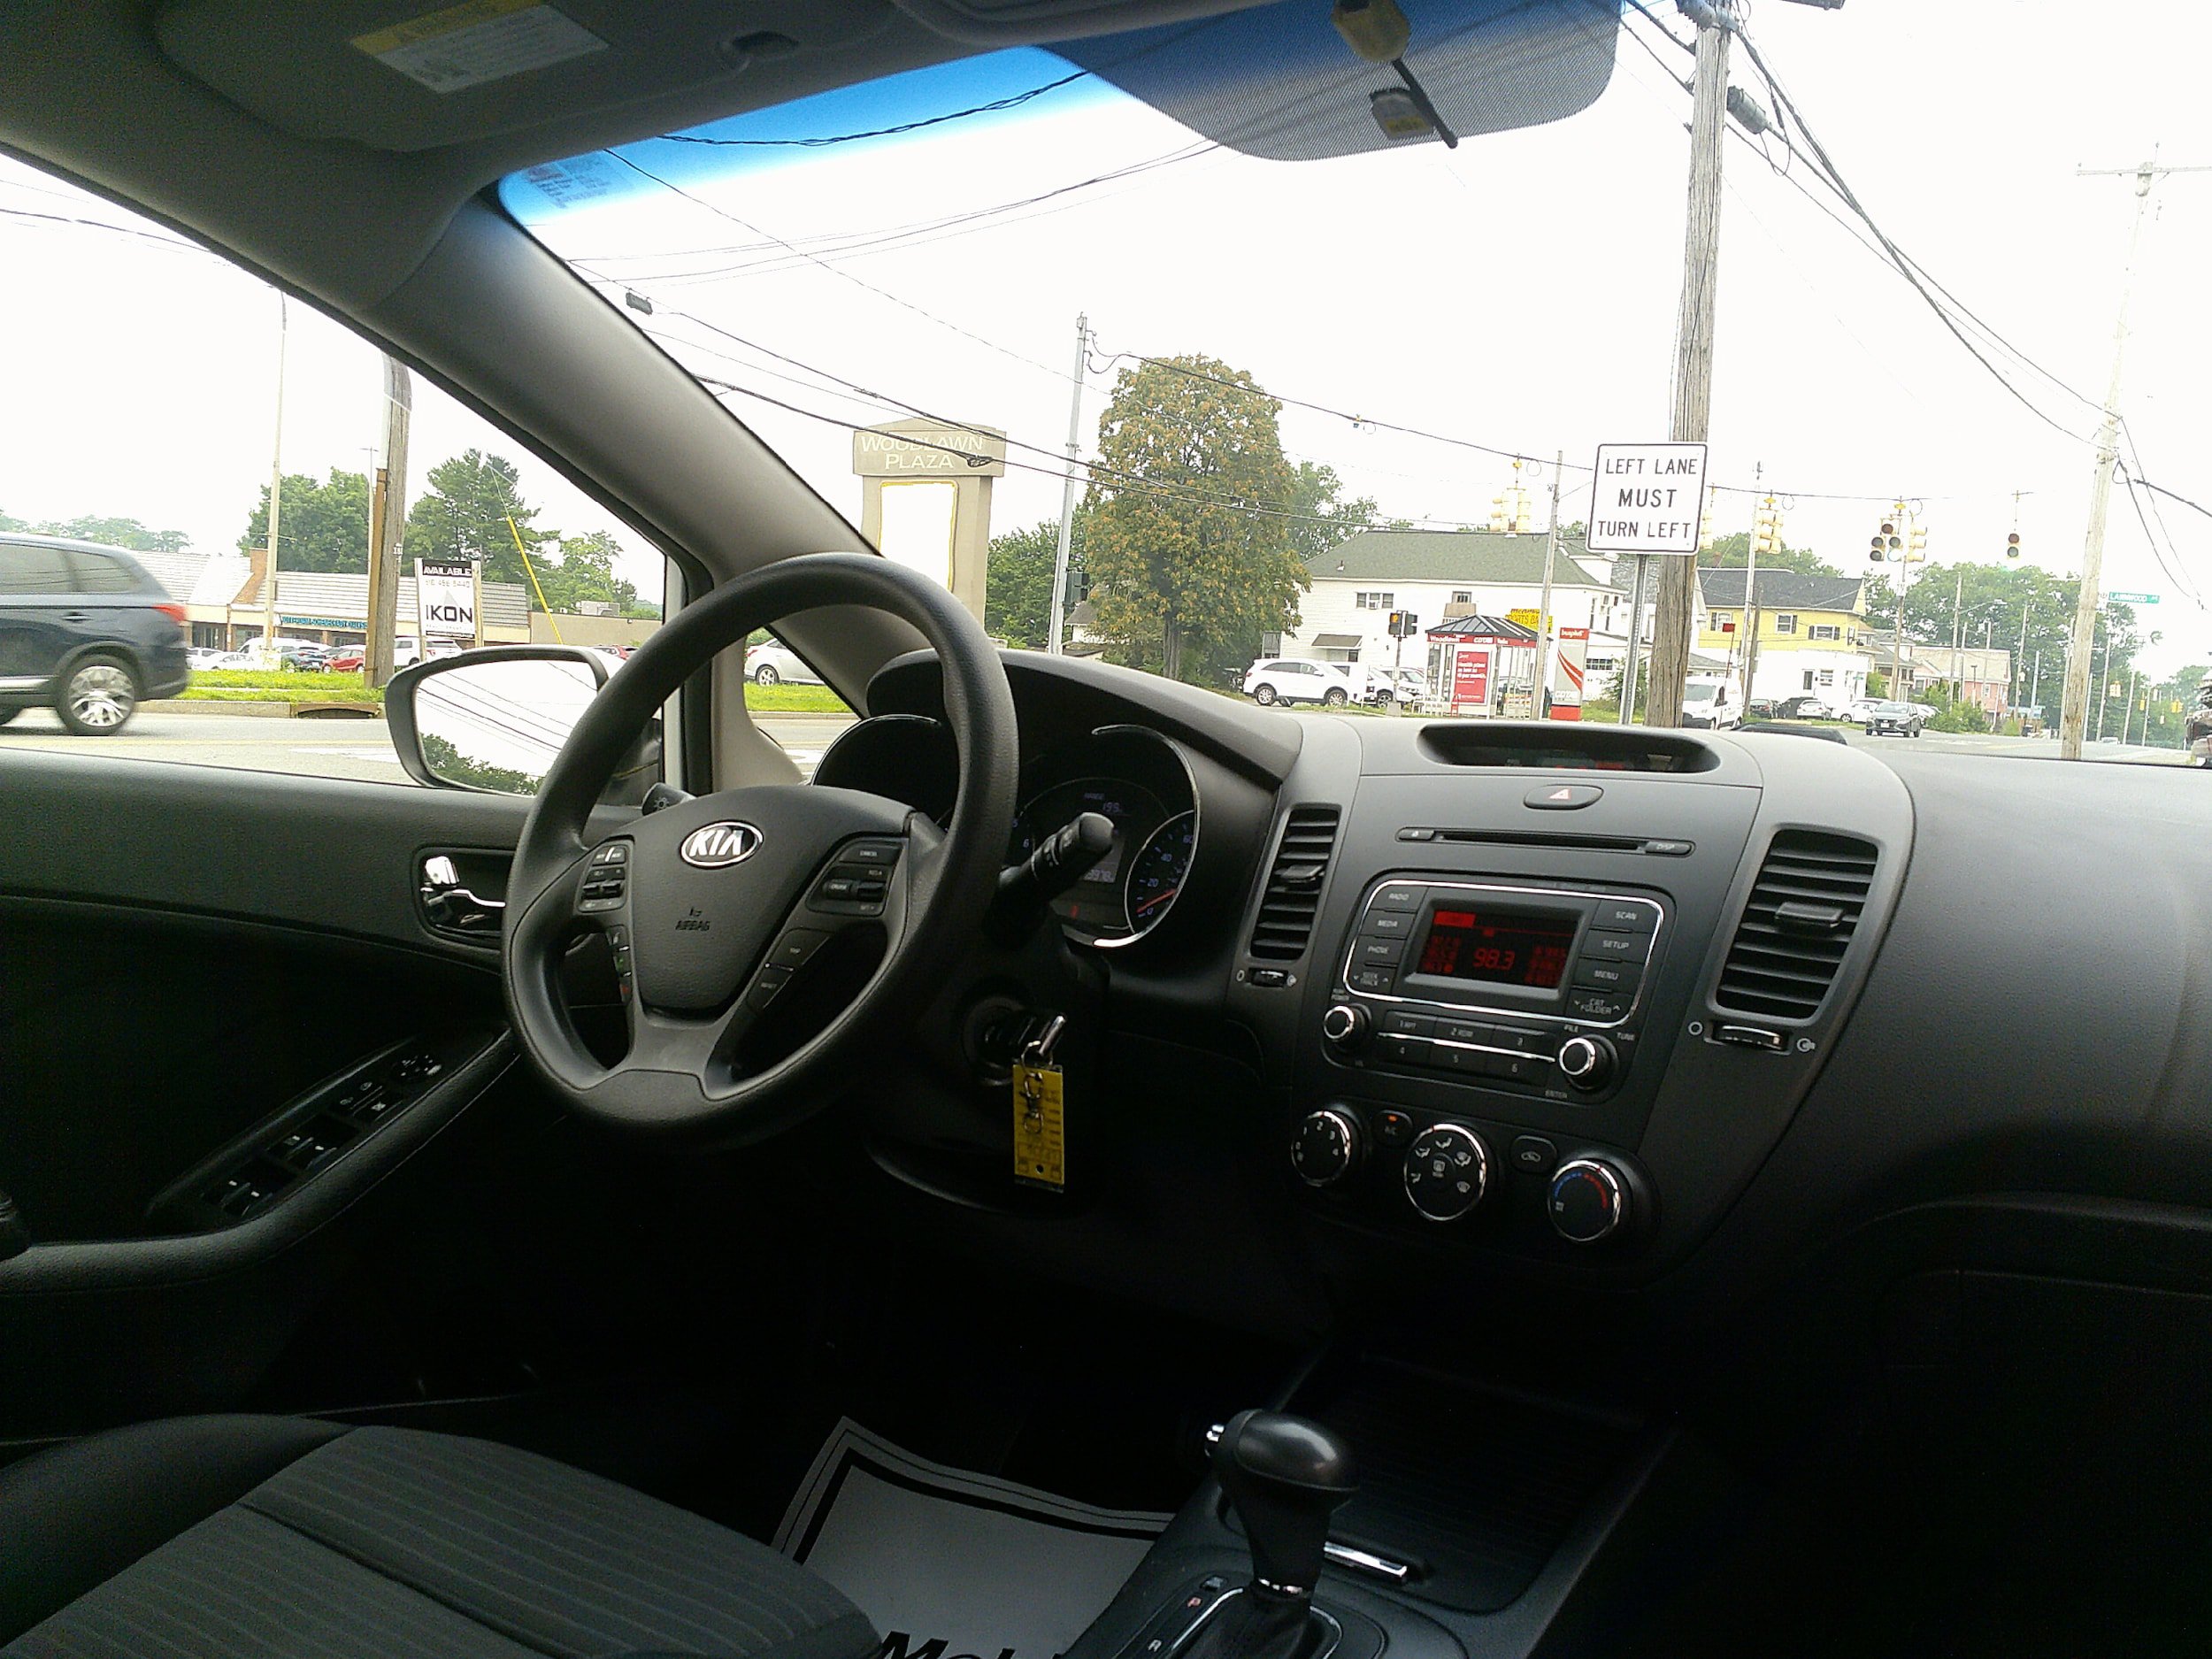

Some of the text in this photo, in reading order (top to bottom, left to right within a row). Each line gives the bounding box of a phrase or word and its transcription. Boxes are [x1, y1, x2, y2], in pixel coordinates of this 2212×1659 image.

[861, 434, 983, 452] WOODLAWN
[885, 453, 954, 470] PLAZA
[1606, 458, 1698, 474] LEFT LANE
[1618, 488, 1677, 508] MUST
[1598, 520, 1691, 539] TURN LEFT
[424, 566, 472, 576] AVAILABLE
[426, 604, 472, 623] IKON
[689, 830, 744, 857] KIA
[1615, 910, 1637, 920] SCAN
[1602, 940, 1630, 949] SETUP
[1594, 970, 1619, 980] MENU
[1580, 1004, 1612, 1015] FOLDER
